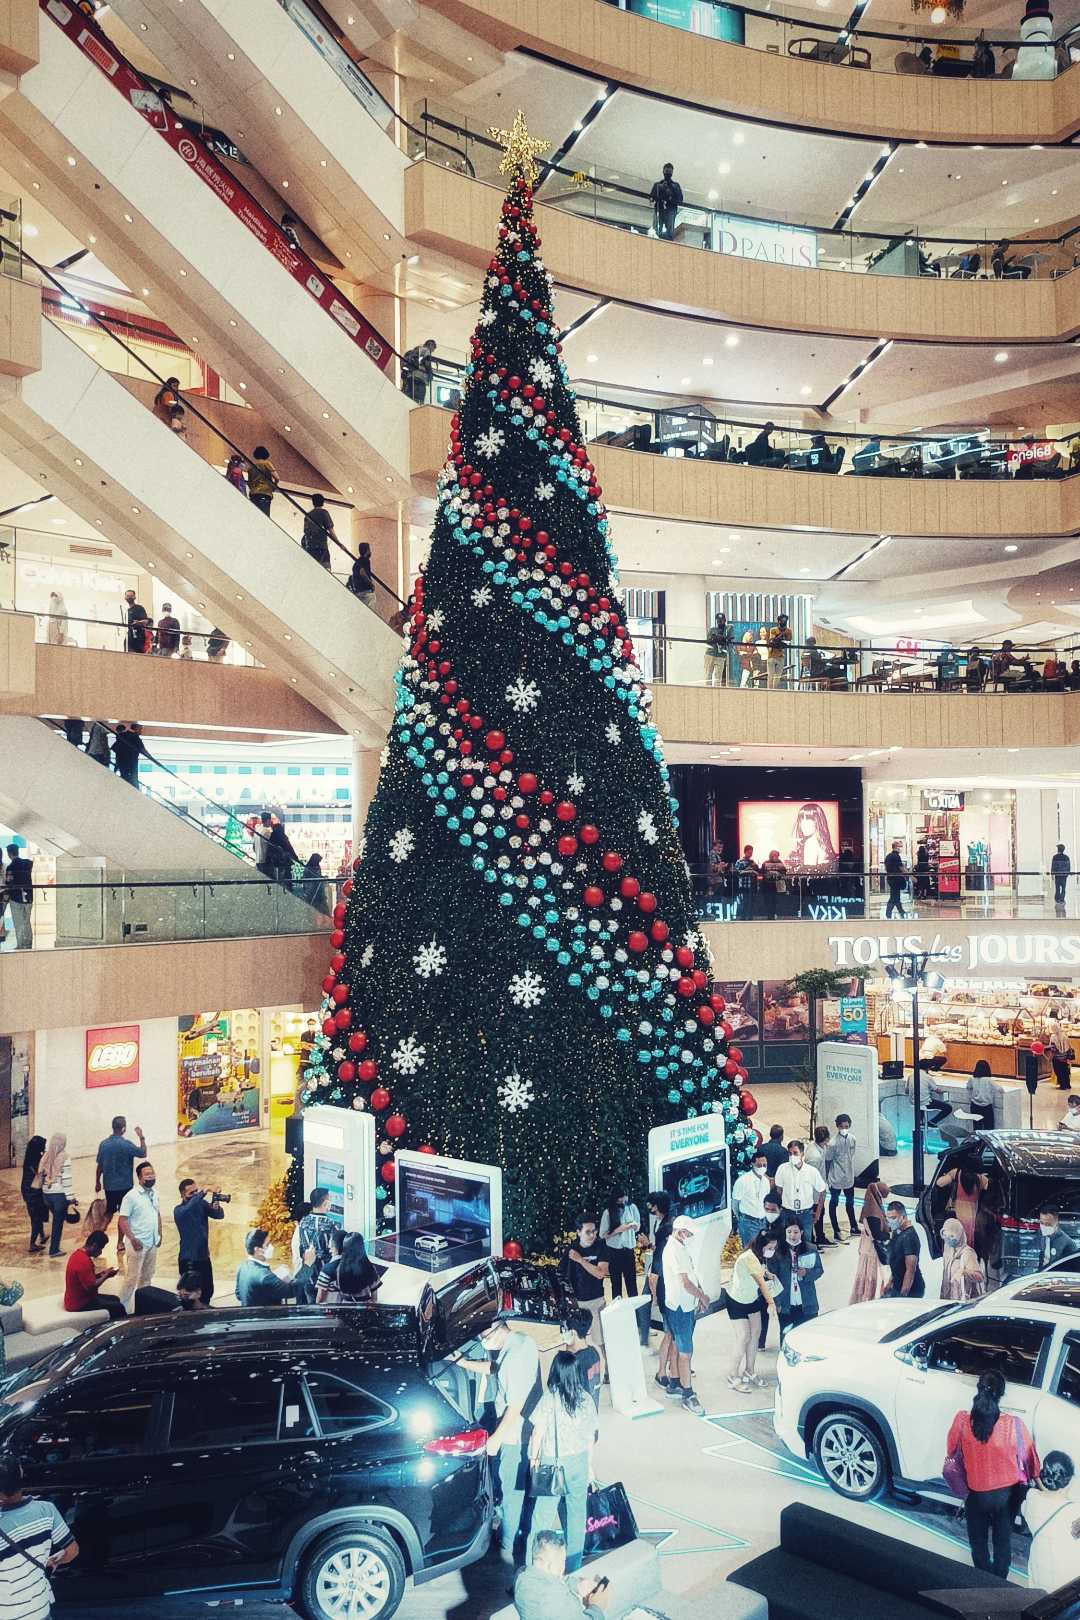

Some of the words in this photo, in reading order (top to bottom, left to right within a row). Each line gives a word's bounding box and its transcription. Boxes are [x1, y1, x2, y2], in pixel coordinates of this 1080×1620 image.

[827, 935, 923, 966] TOUS
[929, 933, 963, 963] les
[968, 934, 1080, 970] JOURS
[90, 1043, 137, 1070] LEGO
[826, 1071, 862, 1082] EVERYONE
[836, 1065, 851, 1073] TIME
[850, 1066, 862, 1074] FOR
[670, 1127, 681, 1139] IT'S
[682, 1124, 697, 1136] TIME
[697, 1121, 709, 1132] FOR
[670, 1133, 710, 1151] EVERYONE
